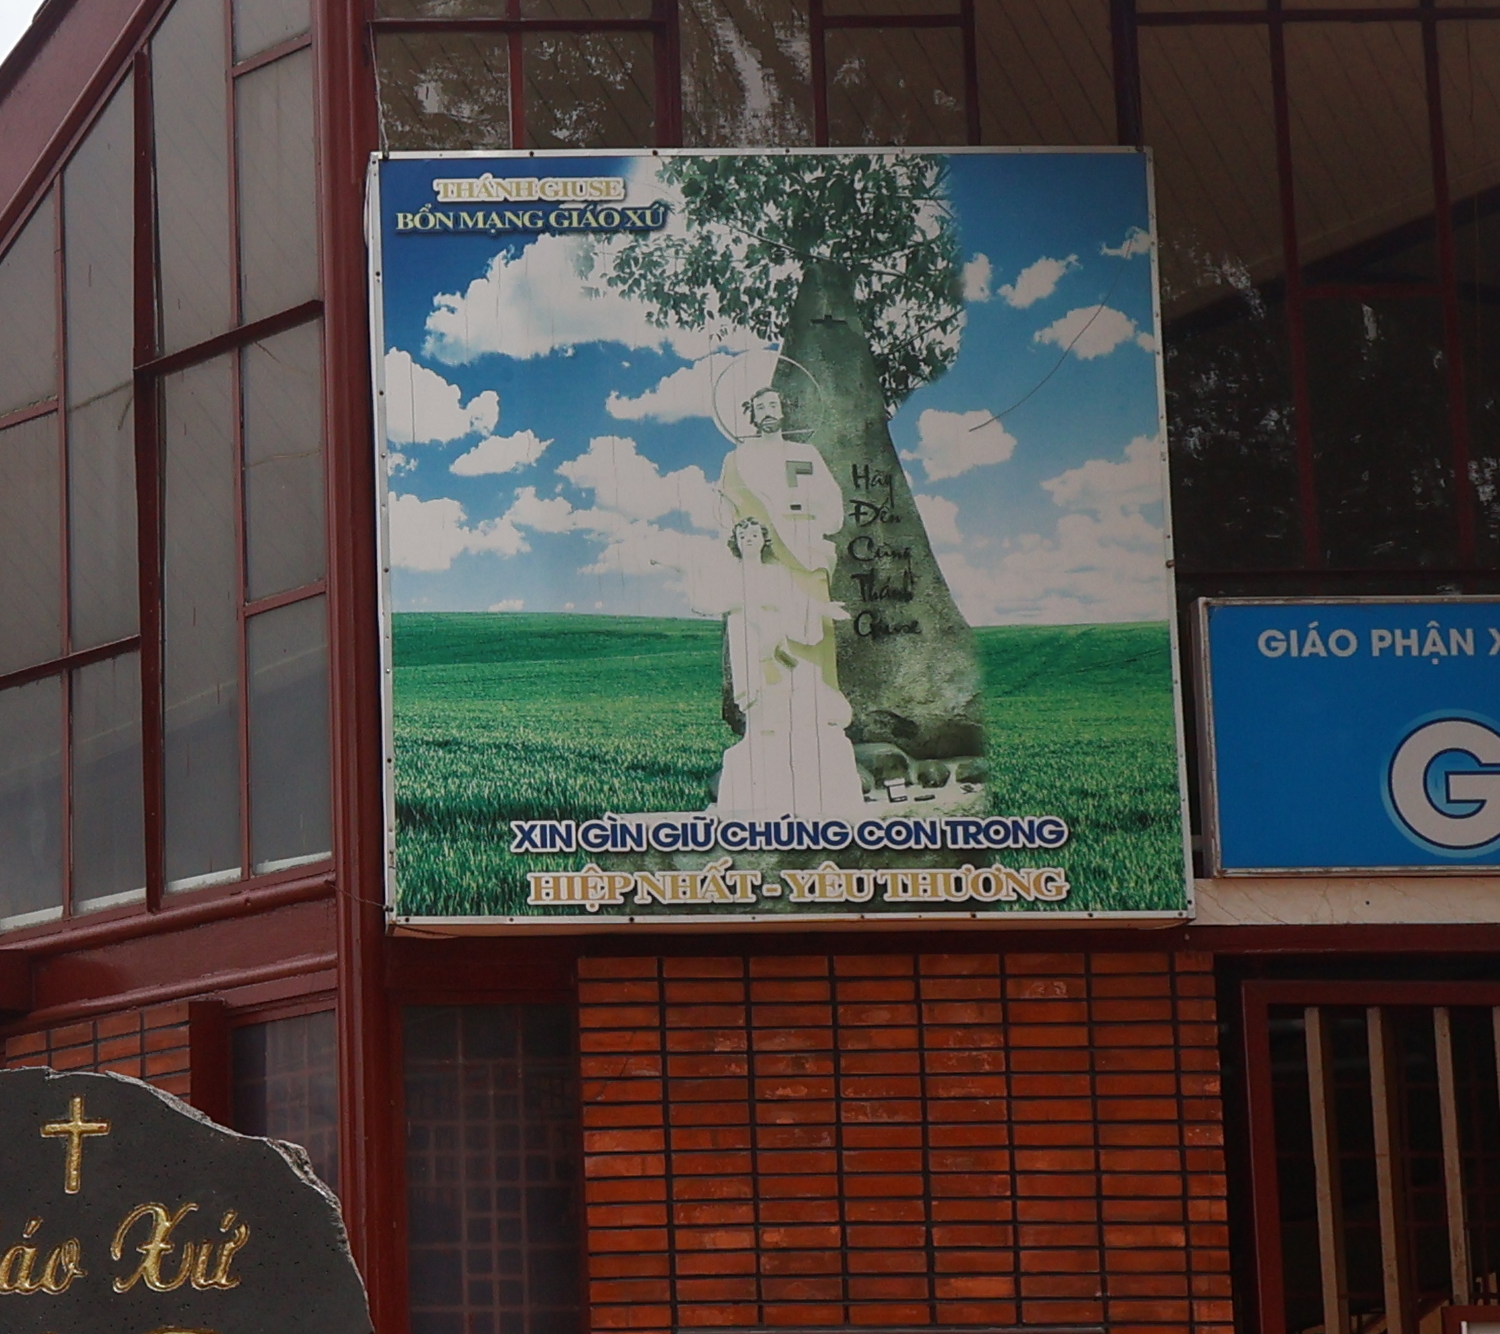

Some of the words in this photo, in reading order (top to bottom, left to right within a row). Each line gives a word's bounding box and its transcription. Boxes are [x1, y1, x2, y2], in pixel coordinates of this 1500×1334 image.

[437, 175, 534, 199] THÁNH
[539, 179, 622, 199] GIUSE
[395, 202, 454, 230] BỔN
[458, 209, 544, 234] MẠNG
[550, 205, 620, 229] GIÁO
[624, 203, 666, 228] XỨ
[1257, 621, 1359, 658] GIÁO
[1371, 620, 1476, 665] PHẬN
[512, 823, 573, 849] XIN
[580, 815, 644, 849] GÌN
[651, 816, 717, 848] GIỮ
[719, 813, 851, 848] CHÚNG
[856, 819, 938, 847] CON
[944, 818, 1066, 846] TRONG
[530, 865, 633, 910] HIỆP
[635, 858, 759, 902] NHẤT
[783, 864, 872, 901] YÊU
[879, 865, 1067, 900] THƯƠNG
[111, 1201, 251, 1293] Xứ
